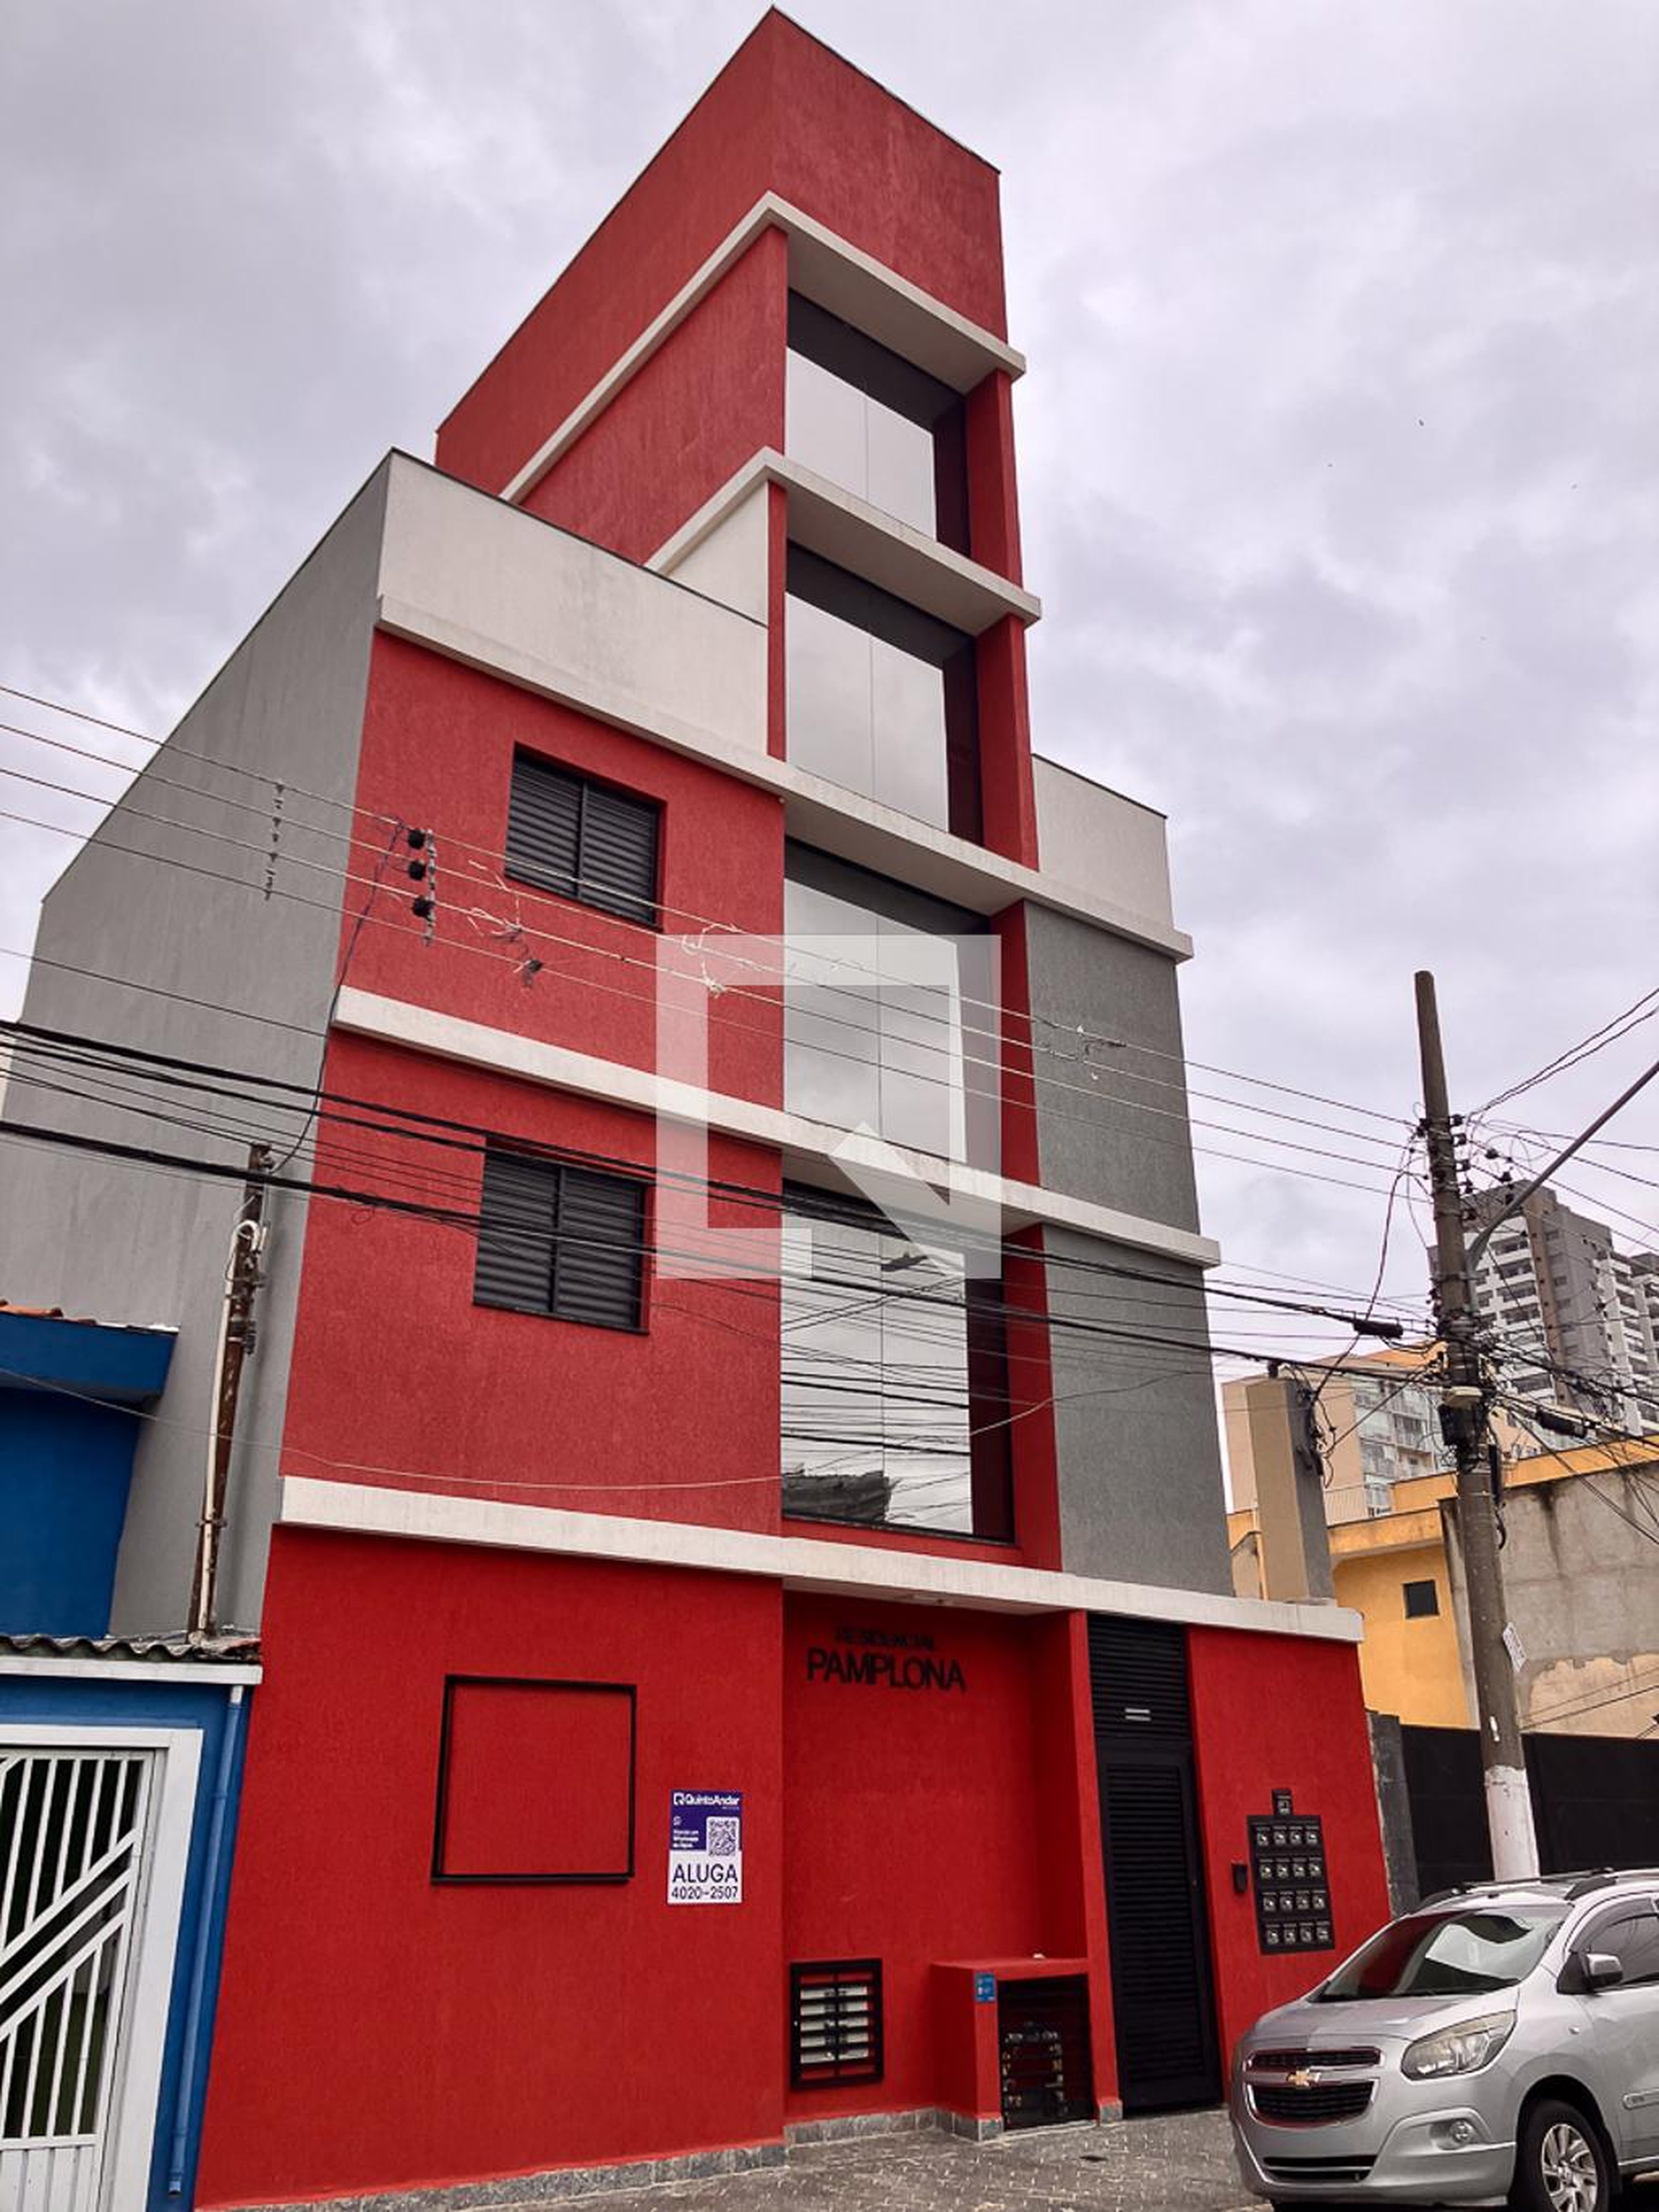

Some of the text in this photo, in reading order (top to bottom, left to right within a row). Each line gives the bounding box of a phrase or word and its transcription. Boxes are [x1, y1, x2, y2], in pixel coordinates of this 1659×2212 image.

[807, 1647, 966, 1693] PAMPLONA
[672, 1864, 738, 1883] ALUGA
[672, 1886, 738, 1900] 4020-2507
